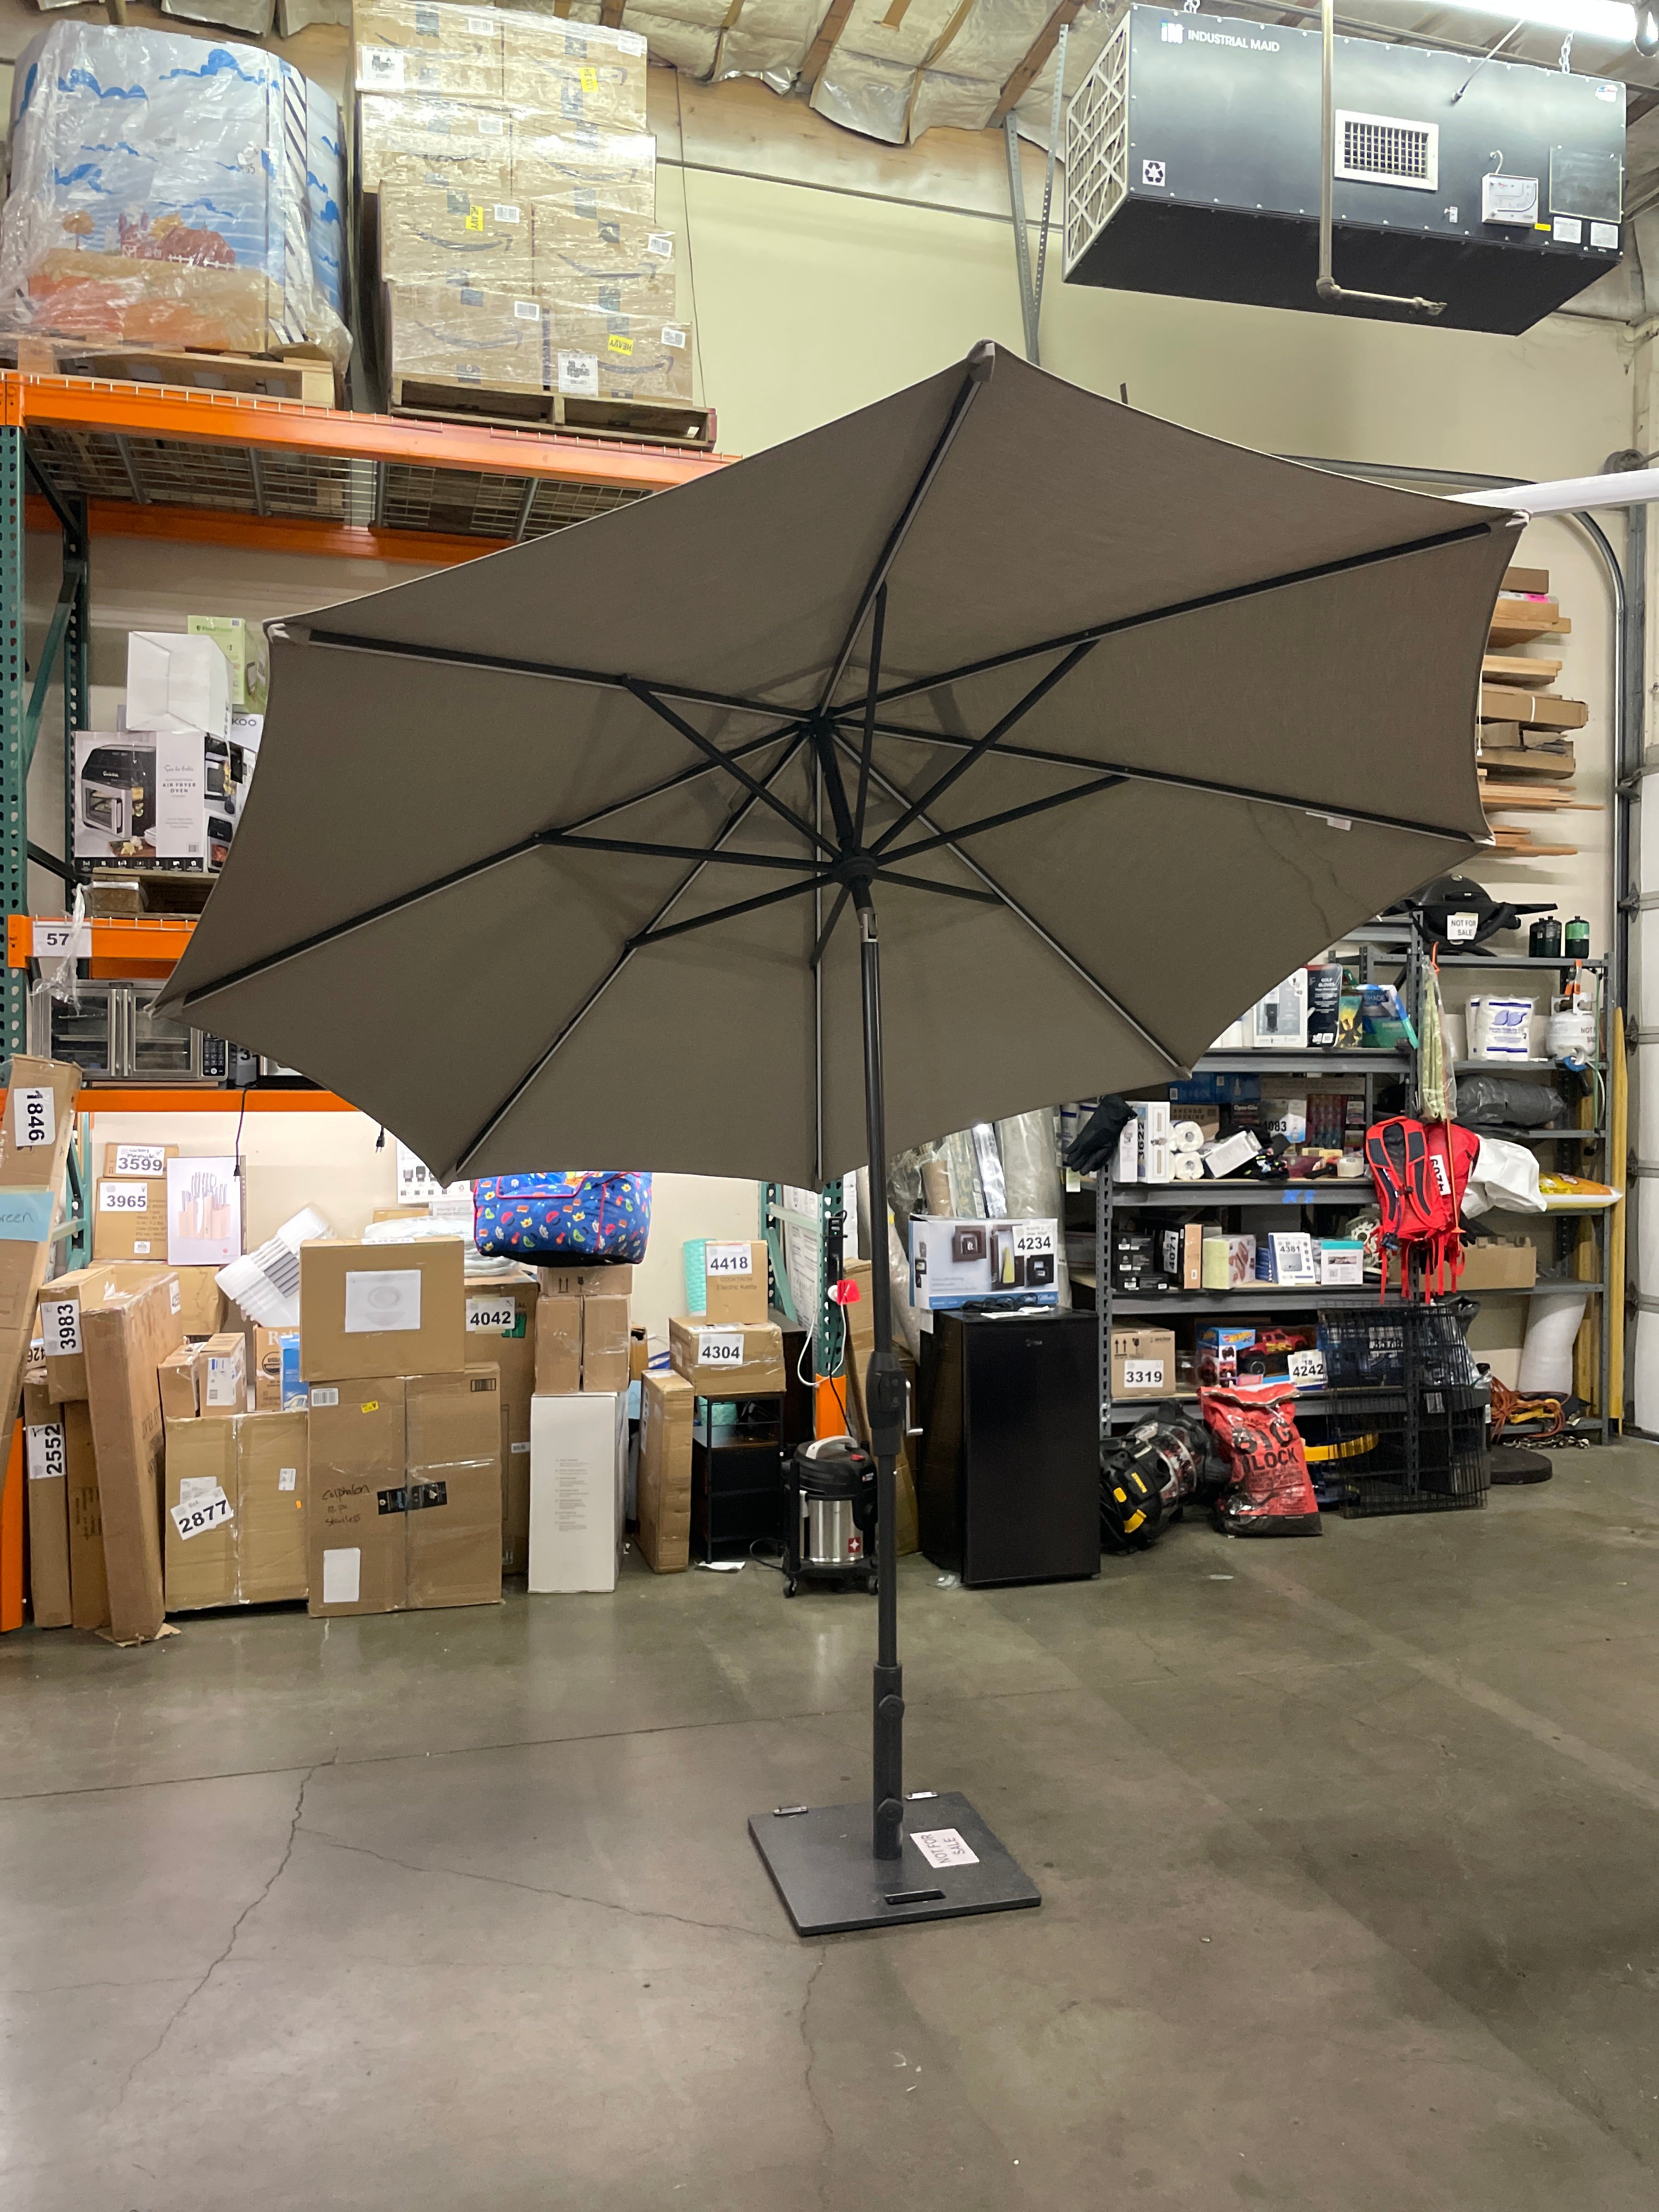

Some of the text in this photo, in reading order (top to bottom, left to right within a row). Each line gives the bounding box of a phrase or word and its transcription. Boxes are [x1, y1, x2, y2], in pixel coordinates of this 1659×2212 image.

[1188, 30, 1280, 52] INDUSTRIAL MAID
[610, 339, 632, 351] HEAVY
[47, 933, 69, 945] 57
[27, 1090, 44, 1141] 1846
[118, 1158, 163, 1171] 3599
[106, 1195, 146, 1207] 3965
[1018, 1237, 1051, 1250] 4234
[710, 1257, 748, 1270] 4418
[470, 1311, 511, 1325] 4042
[57, 1305, 76, 1348] 3983
[702, 1346, 740, 1359] 4304
[1293, 1364, 1324, 1377] 4242
[1126, 1372, 1162, 1383] 3319
[45, 1424, 62, 1475] 2552
[179, 1500, 226, 1533] 2877
[922, 1834, 952, 1863] NOT FOR
[944, 1837, 965, 1854] SALE
